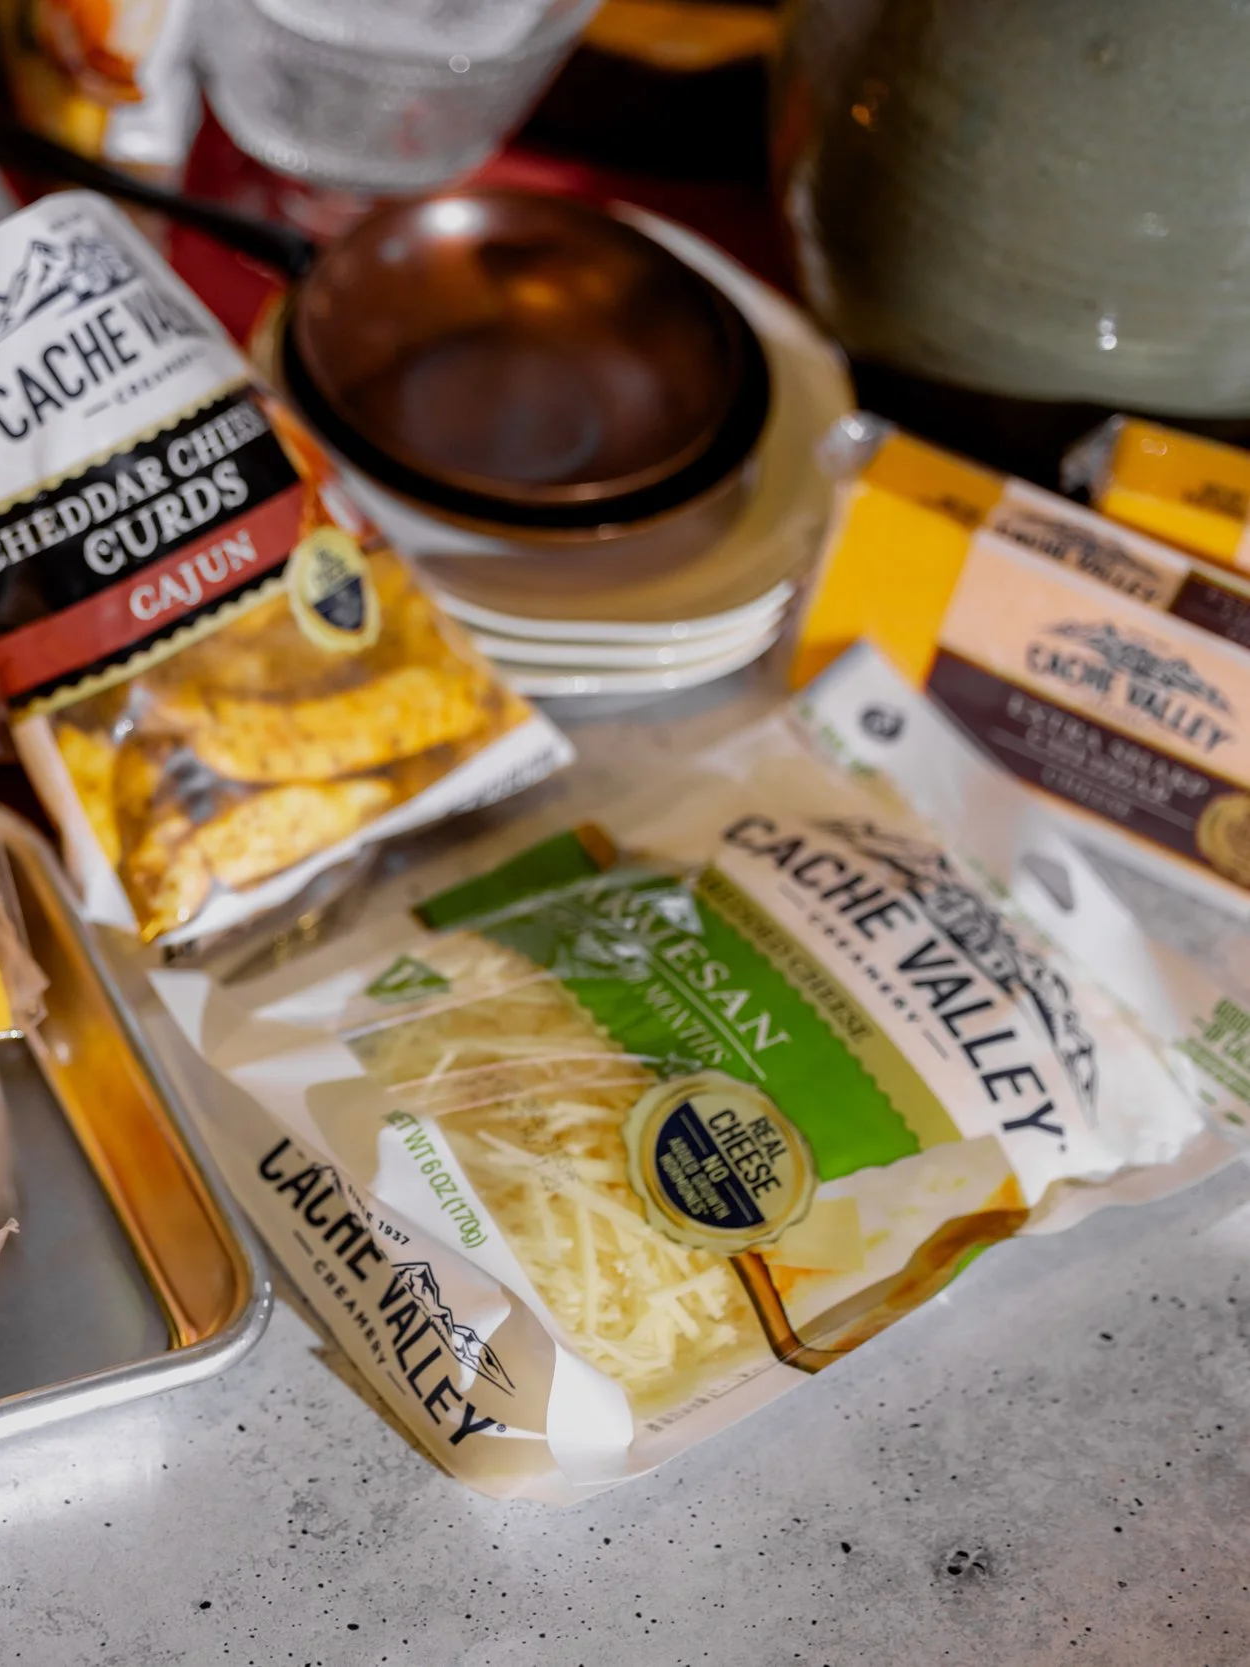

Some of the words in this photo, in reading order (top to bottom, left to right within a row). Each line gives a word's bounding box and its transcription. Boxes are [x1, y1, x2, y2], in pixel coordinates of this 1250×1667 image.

[83, 459, 249, 576] CURDS
[128, 529, 257, 621] CAJUN
[1025, 641, 1112, 695] CACHE
[1125, 677, 1231, 754] VALLEY
[723, 814, 917, 942] CACHE
[402, 1127, 436, 1167] WT
[422, 1158, 442, 1177] 6
[702, 1152, 730, 1184] NO
[707, 1108, 782, 1199] CHEESE
[749, 1115, 787, 1165] REAL
[428, 1169, 455, 1201] OZ
[377, 1219, 411, 1247] 1937
[440, 1194, 490, 1250] (170g)
[312, 1258, 388, 1367] CREAMERY
